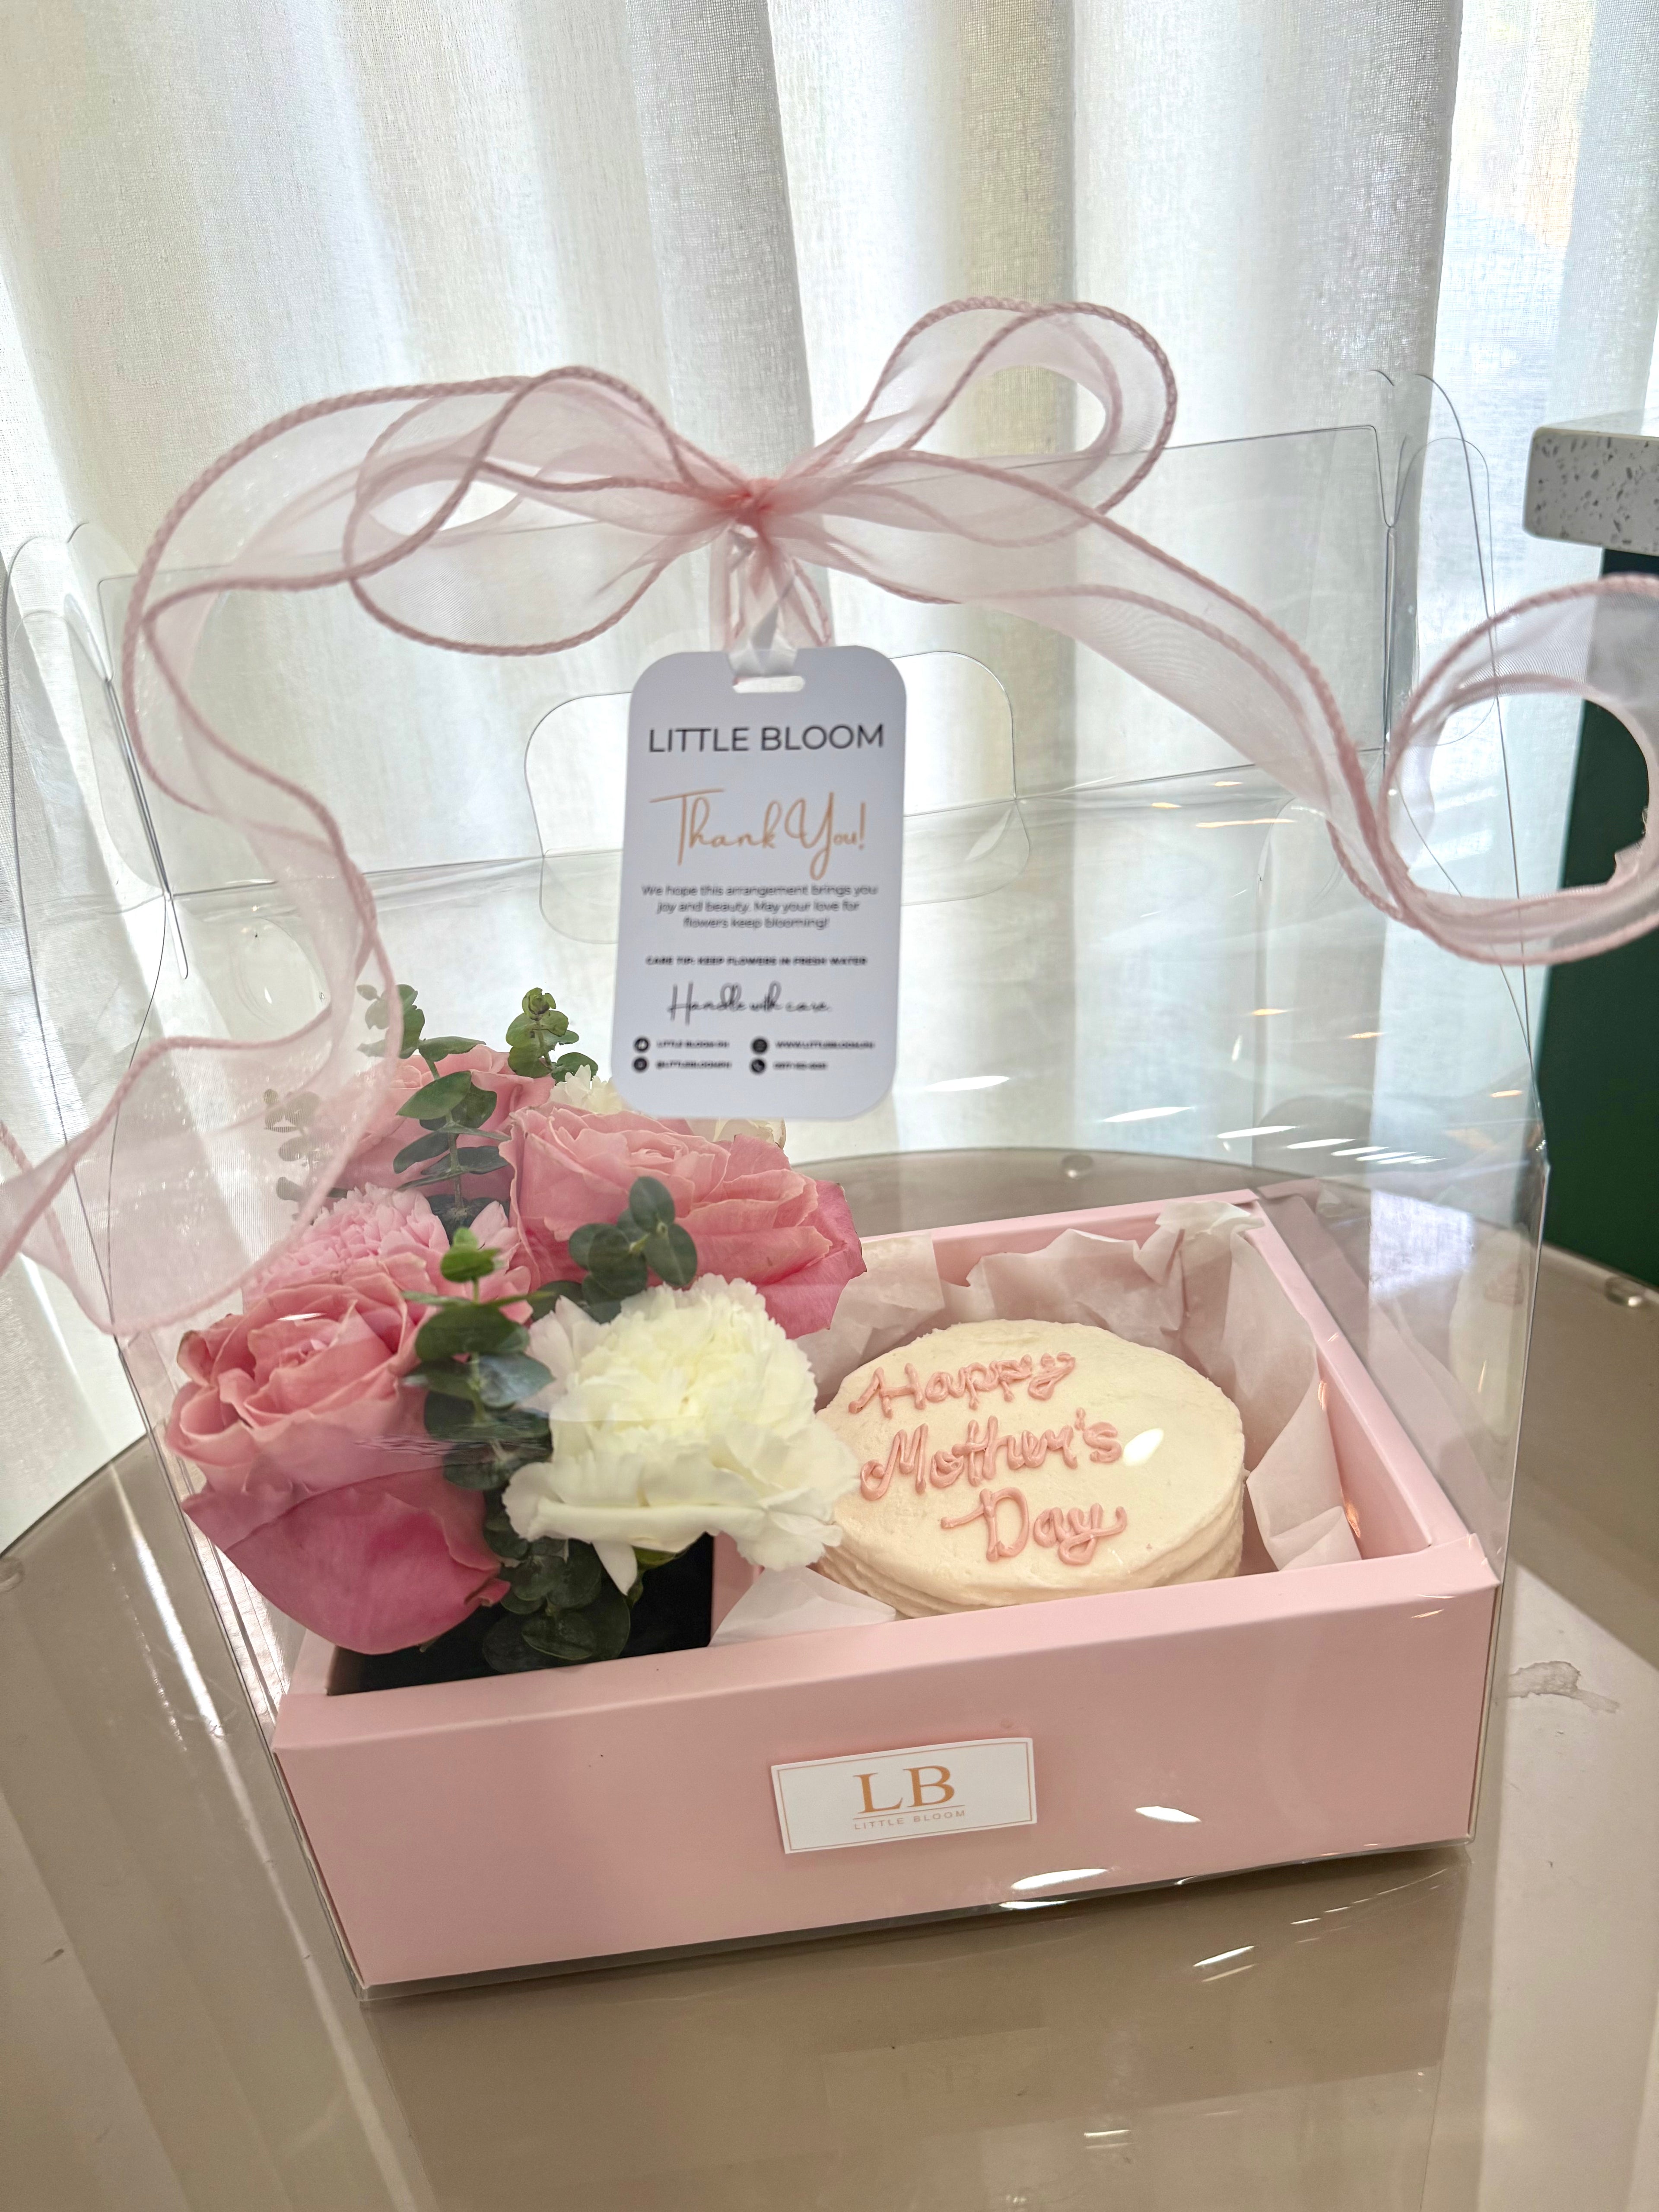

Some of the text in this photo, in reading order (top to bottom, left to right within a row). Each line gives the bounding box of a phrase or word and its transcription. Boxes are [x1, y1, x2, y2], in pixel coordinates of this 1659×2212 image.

[650, 724, 884, 753] LITTLE BLOOM
[649, 789, 866, 880] Thank You!
[642, 885, 879, 898] We hope this arrangement brings you
[657, 903, 677, 915] joy
[679, 902, 703, 912] and
[754, 902, 781, 915] May
[782, 903, 811, 915] your
[814, 902, 840, 912] love
[842, 901, 860, 912] for
[684, 917, 830, 931] flowers keep blooming!
[646, 956, 674, 966] CARE
[697, 957, 725, 966] KEEP
[726, 957, 778, 966] FLOWERS
[829, 956, 868, 966] WATER
[667, 982, 747, 1025] Handle
[749, 982, 783, 1013] with
[849, 1352, 1076, 1418] Happy
[941, 1487, 1128, 1565] Day
[853, 1765, 955, 1813] LB
[854, 1810, 965, 1830] LITTLE BLOOM
